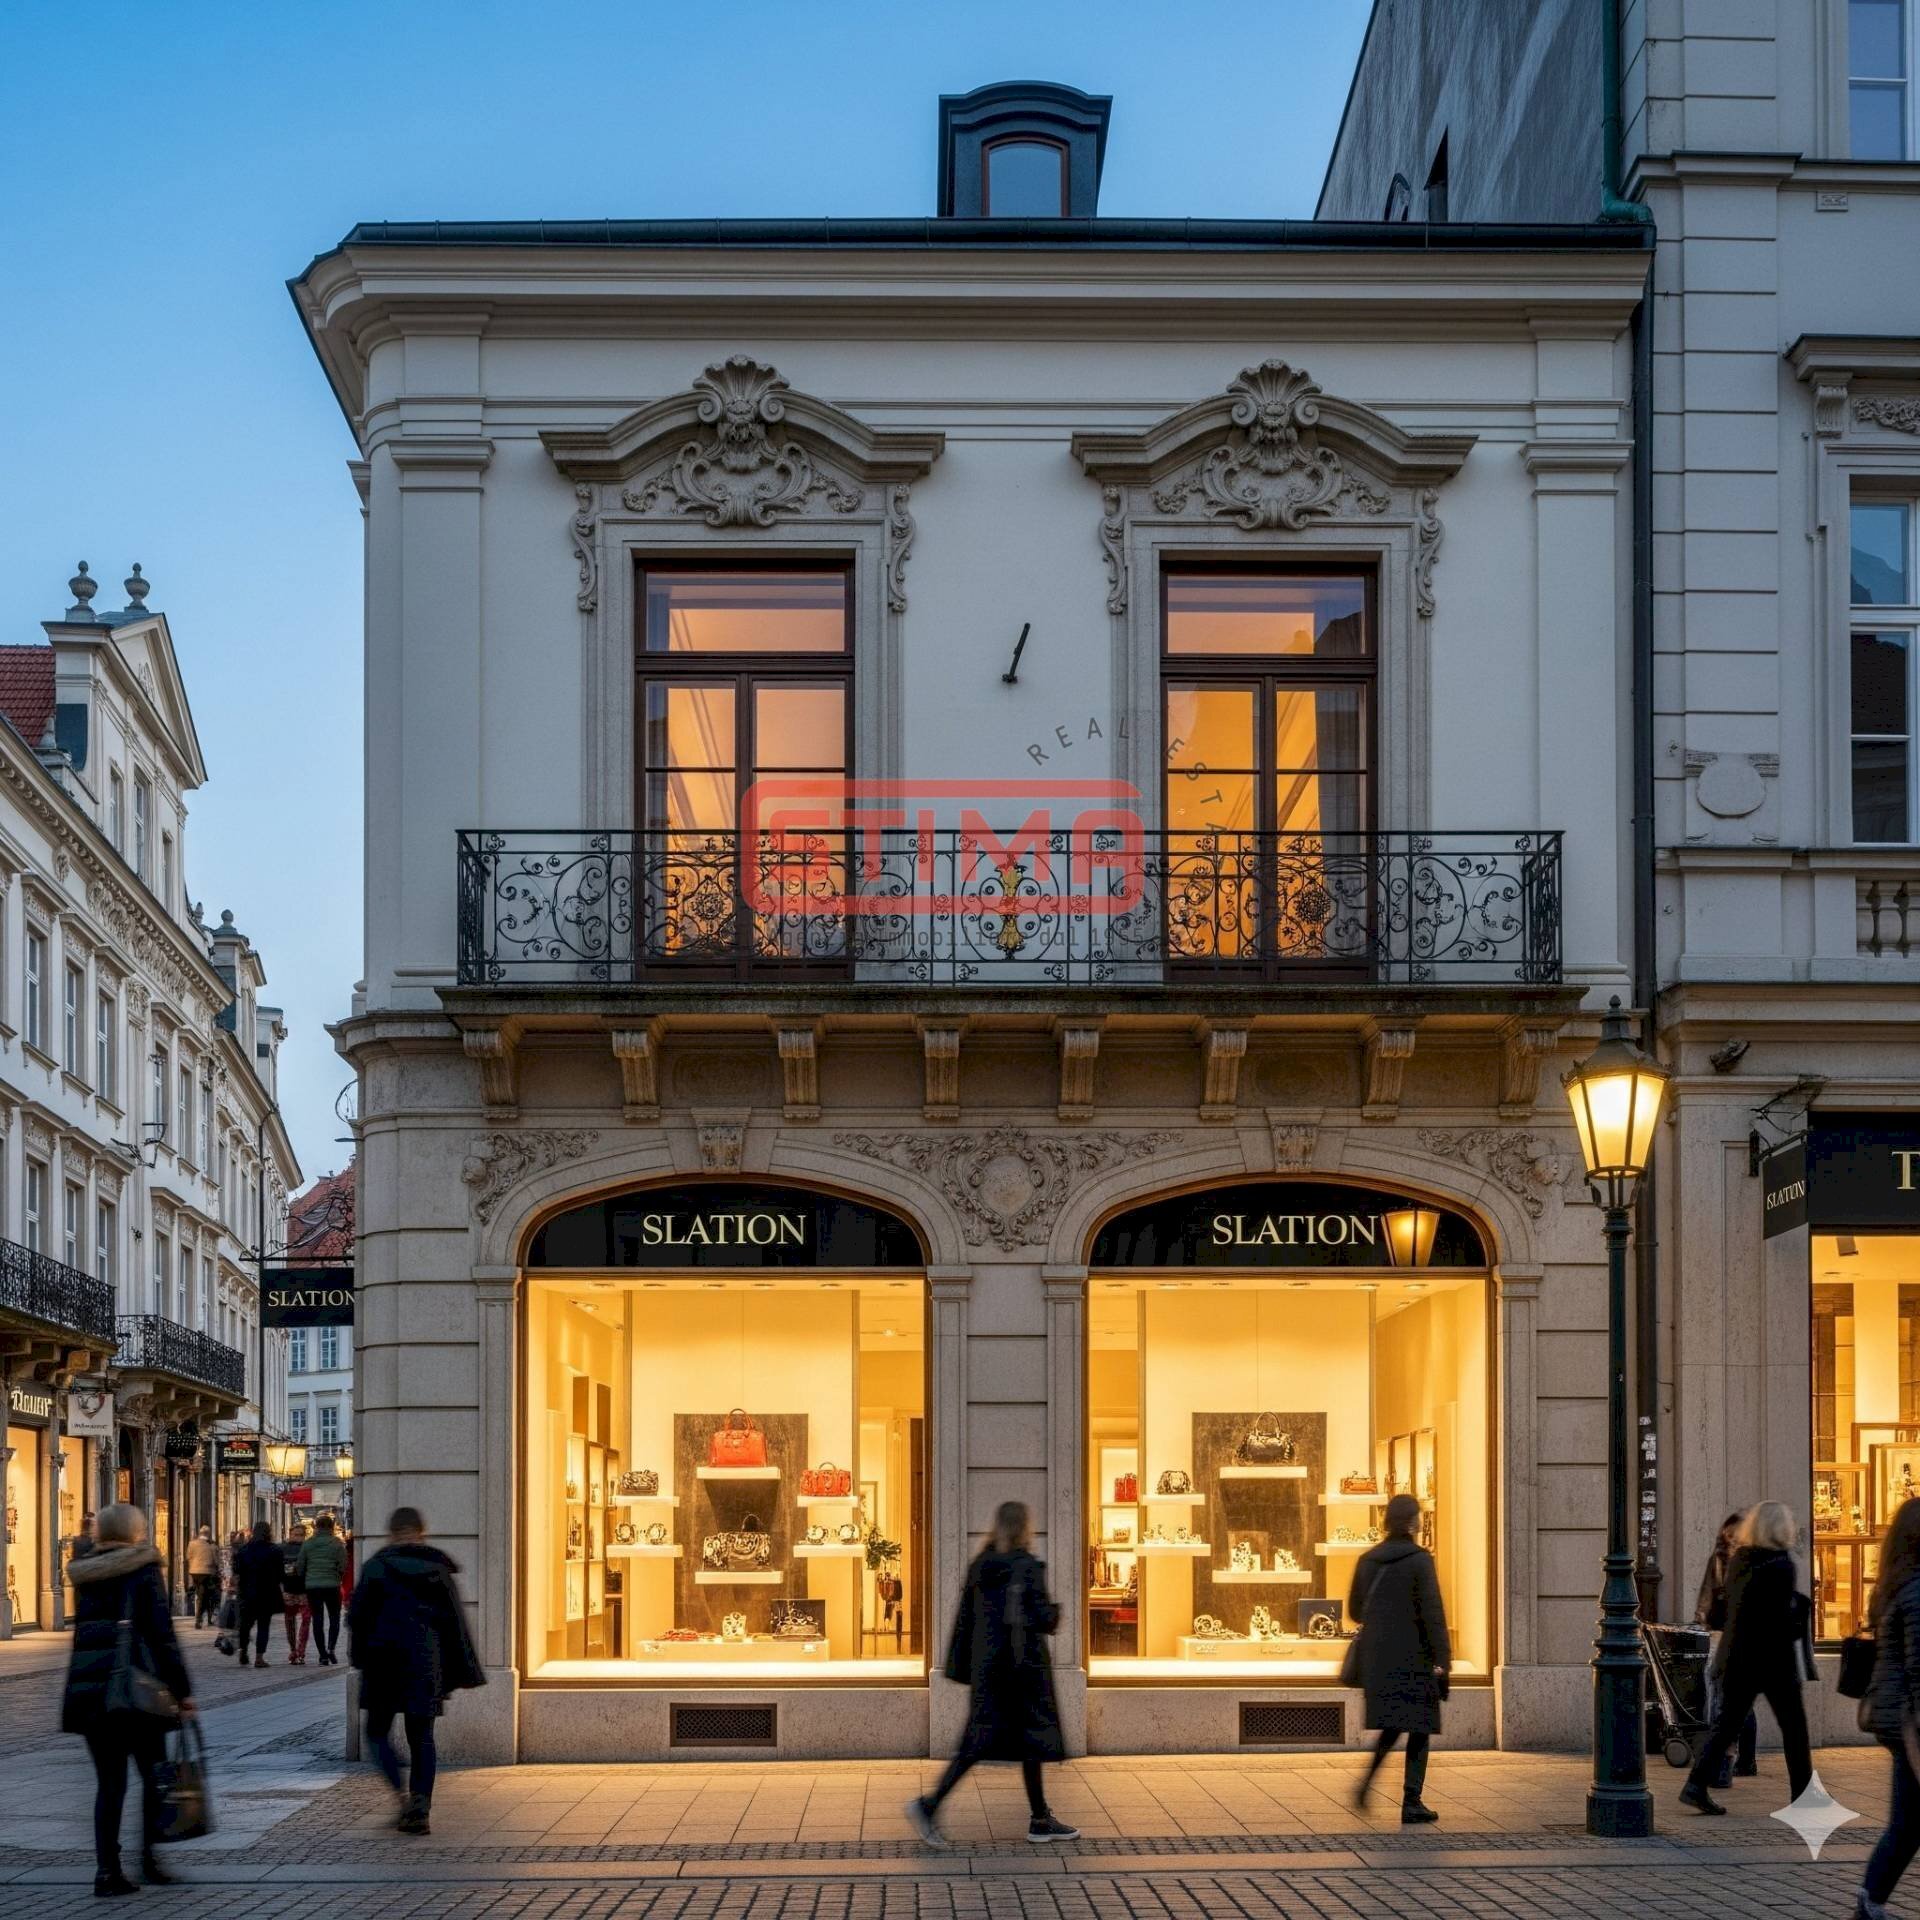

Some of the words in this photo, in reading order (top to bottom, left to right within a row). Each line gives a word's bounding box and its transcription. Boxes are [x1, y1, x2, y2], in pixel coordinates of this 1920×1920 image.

[1891, 1151, 1920, 1190] T
[642, 1214, 806, 1246] SLATION
[1213, 1214, 1377, 1246] SLATION
